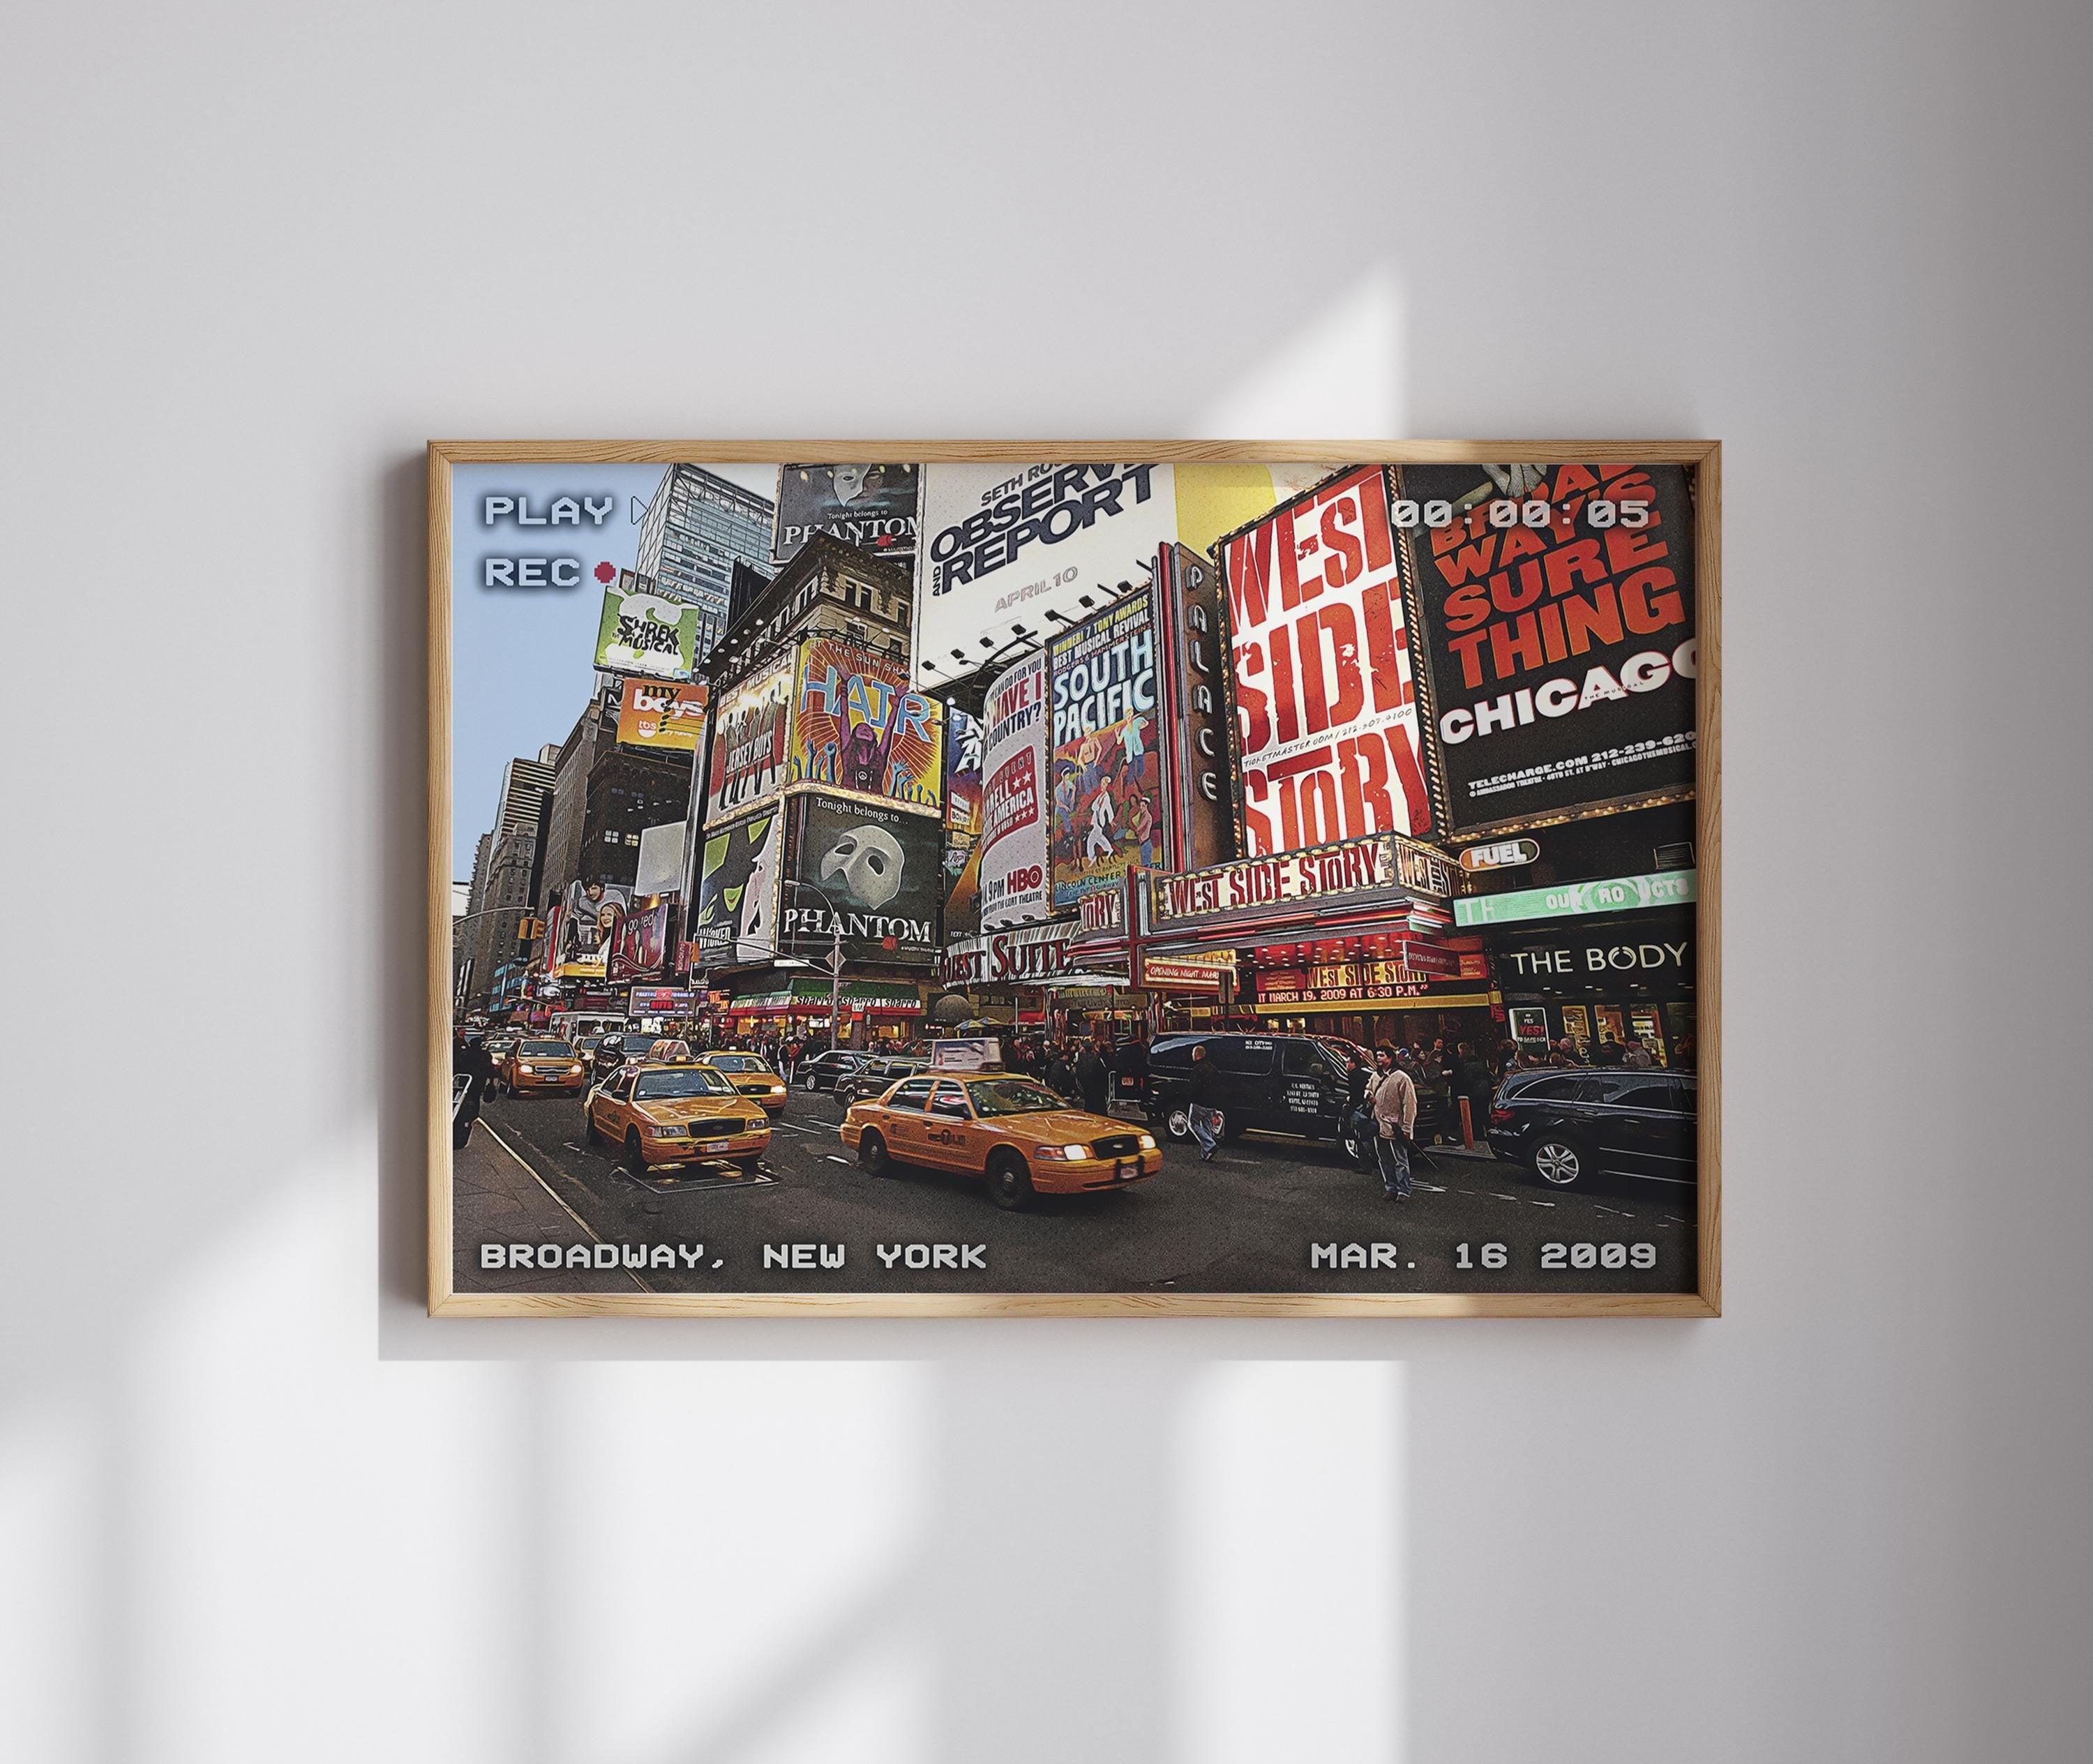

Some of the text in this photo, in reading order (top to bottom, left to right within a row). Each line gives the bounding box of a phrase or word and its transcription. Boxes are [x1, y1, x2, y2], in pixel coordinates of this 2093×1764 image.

[981, 463, 1063, 506] SETH RO
[827, 511, 852, 520] Tonight
[853, 509, 879, 518] belongs
[931, 463, 1136, 562] OBSERV
[932, 464, 1160, 597] AND REPORT
[1224, 463, 1393, 636] WEST
[1443, 510, 1668, 631] SURE
[994, 566, 1079, 613] APRIL 10
[617, 613, 680, 645] SHREK
[1086, 627, 1091, 638] 7
[1093, 614, 1114, 634] TONY
[1115, 594, 1148, 622] AWARDS
[1447, 567, 1686, 689] THING
[619, 634, 679, 655] MUSICAL
[828, 643, 850, 657] THE
[856, 653, 879, 667] SUN
[1053, 610, 1150, 668] BEST MUSICAL REVIVAL
[719, 652, 793, 709] BEST MUSICAL
[1014, 667, 1027, 685] FOR
[1028, 657, 1042, 675] YOU
[1053, 659, 1084, 676] RODGERS
[1054, 629, 1154, 710] SOUTH
[1232, 576, 1417, 756] SIDE
[641, 685, 682, 709] my
[1185, 565, 1218, 802] PALACE
[1604, 682, 1644, 695] MUSICAL
[800, 664, 932, 743] HAIR
[1053, 668, 1155, 747] PACIFIC
[638, 720, 657, 730] tbs
[988, 701, 1042, 752] COUNTRY?
[726, 729, 773, 775] JERSEY BOYS
[1468, 756, 1588, 790] TELECHARGE.COM
[993, 786, 1035, 829] AMERICA
[1243, 724, 1432, 858] STORY
[816, 798, 852, 814] Tonight
[853, 803, 890, 823] belongs
[1471, 842, 1527, 868] FUEL
[1007, 865, 1043, 895] HBO
[1055, 879, 1086, 892] LINCOLN
[1088, 871, 1121, 885] CENTER
[1167, 874, 1224, 915] WEST
[1229, 862, 1290, 906] SIDE
[1300, 842, 1379, 893] STORY
[1019, 890, 1042, 904] THEATRE
[783, 909, 932, 943] PHANTOM
[1150, 966, 1179, 977] OPENING
[1180, 970, 1199, 978] NIGHT
[1510, 950, 1574, 974] THE
[1586, 942, 1688, 971] BODY
[1307, 965, 1342, 989] WEST
[1345, 962, 1381, 986] SIDE
[885, 998, 917, 1008] sbarro
[1269, 992, 1298, 1003] MARCH
[1303, 990, 1317, 1001] 19,
[1320, 989, 1346, 1000] 2009
[1349, 987, 1363, 999] AT
[1367, 987, 1392, 998] 6:30
[1520, 1025, 1545, 1036] YES!
